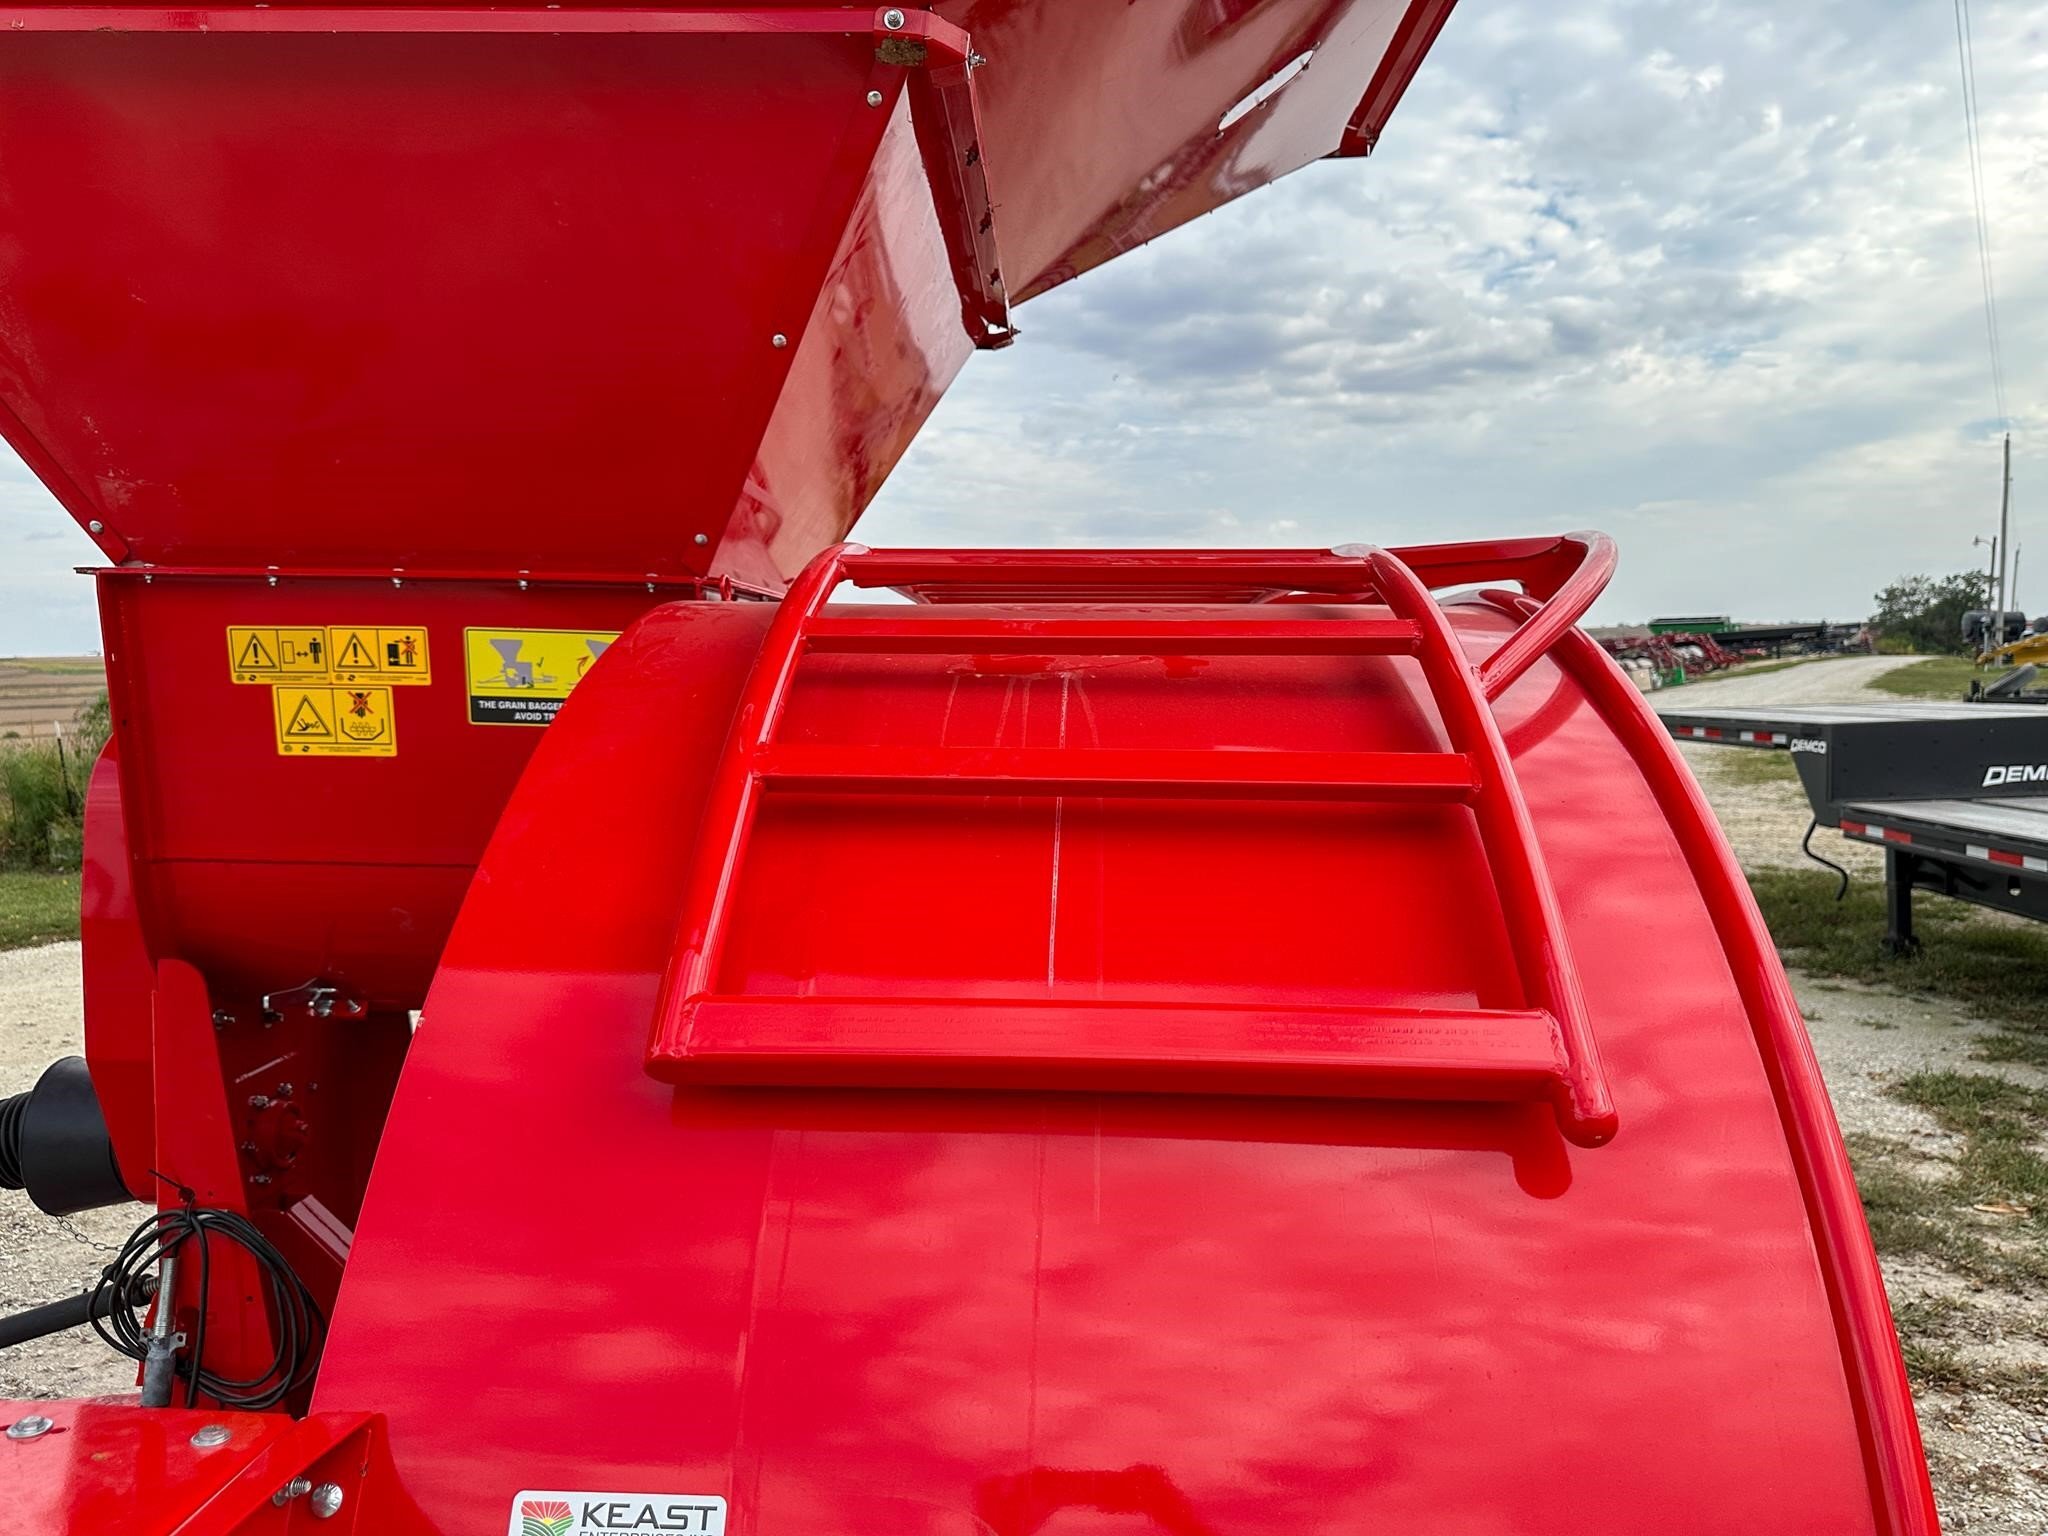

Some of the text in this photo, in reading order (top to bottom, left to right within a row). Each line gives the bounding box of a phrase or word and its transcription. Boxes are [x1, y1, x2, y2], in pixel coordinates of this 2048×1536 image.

[478, 700, 497, 709] THE
[498, 701, 527, 710] GRAIN
[514, 711, 556, 721] AVOID TR
[1981, 764, 2048, 788] DEM
[581, 1502, 718, 1531] KEAST
